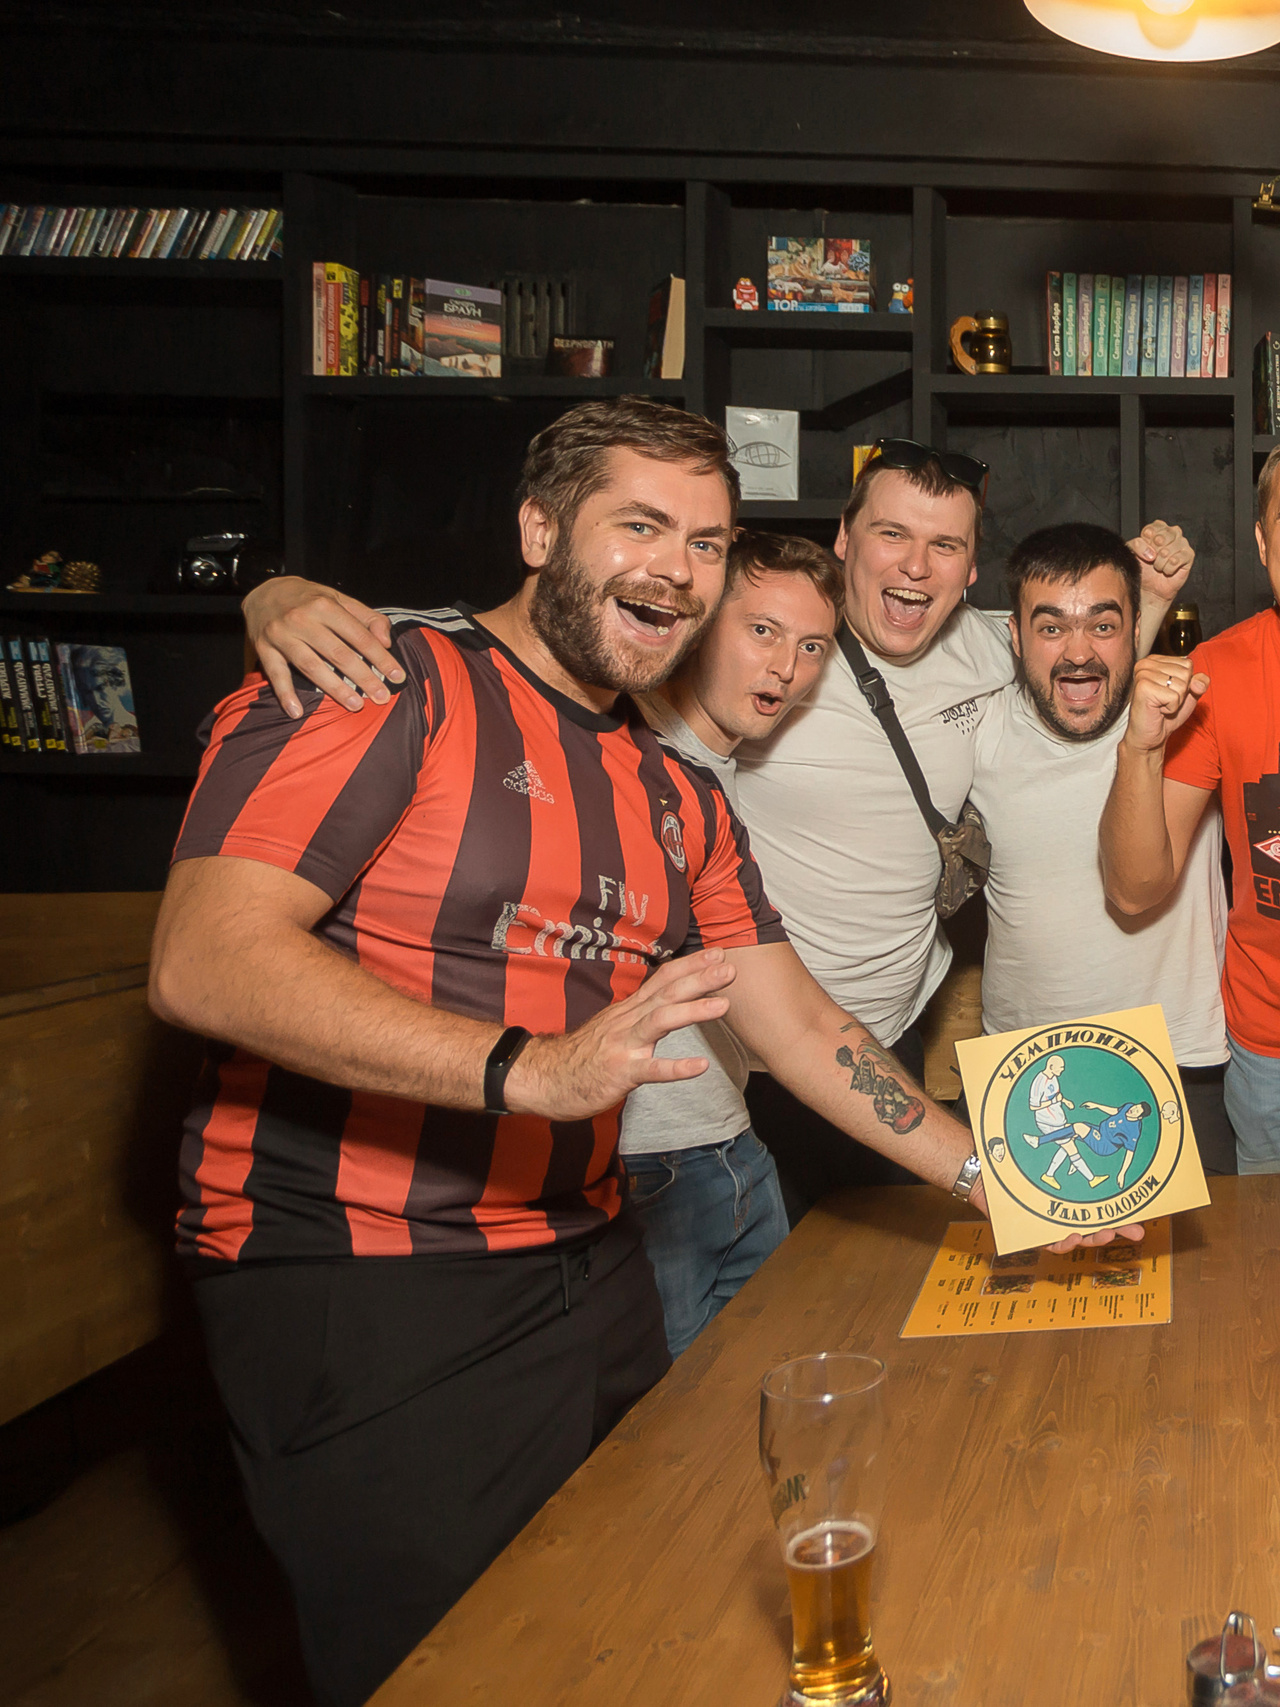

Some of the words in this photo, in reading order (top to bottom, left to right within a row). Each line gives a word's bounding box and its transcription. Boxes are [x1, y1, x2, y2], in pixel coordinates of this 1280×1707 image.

[443, 302, 482, 318] БРАУН
[1052, 302, 1061, 334] Барбара
[1052, 335, 1061, 357] Санта
[502, 777, 555, 805] adidas
[598, 874, 649, 927] Fly
[999, 1028, 1142, 1083] ЧЕМПИОНЫ
